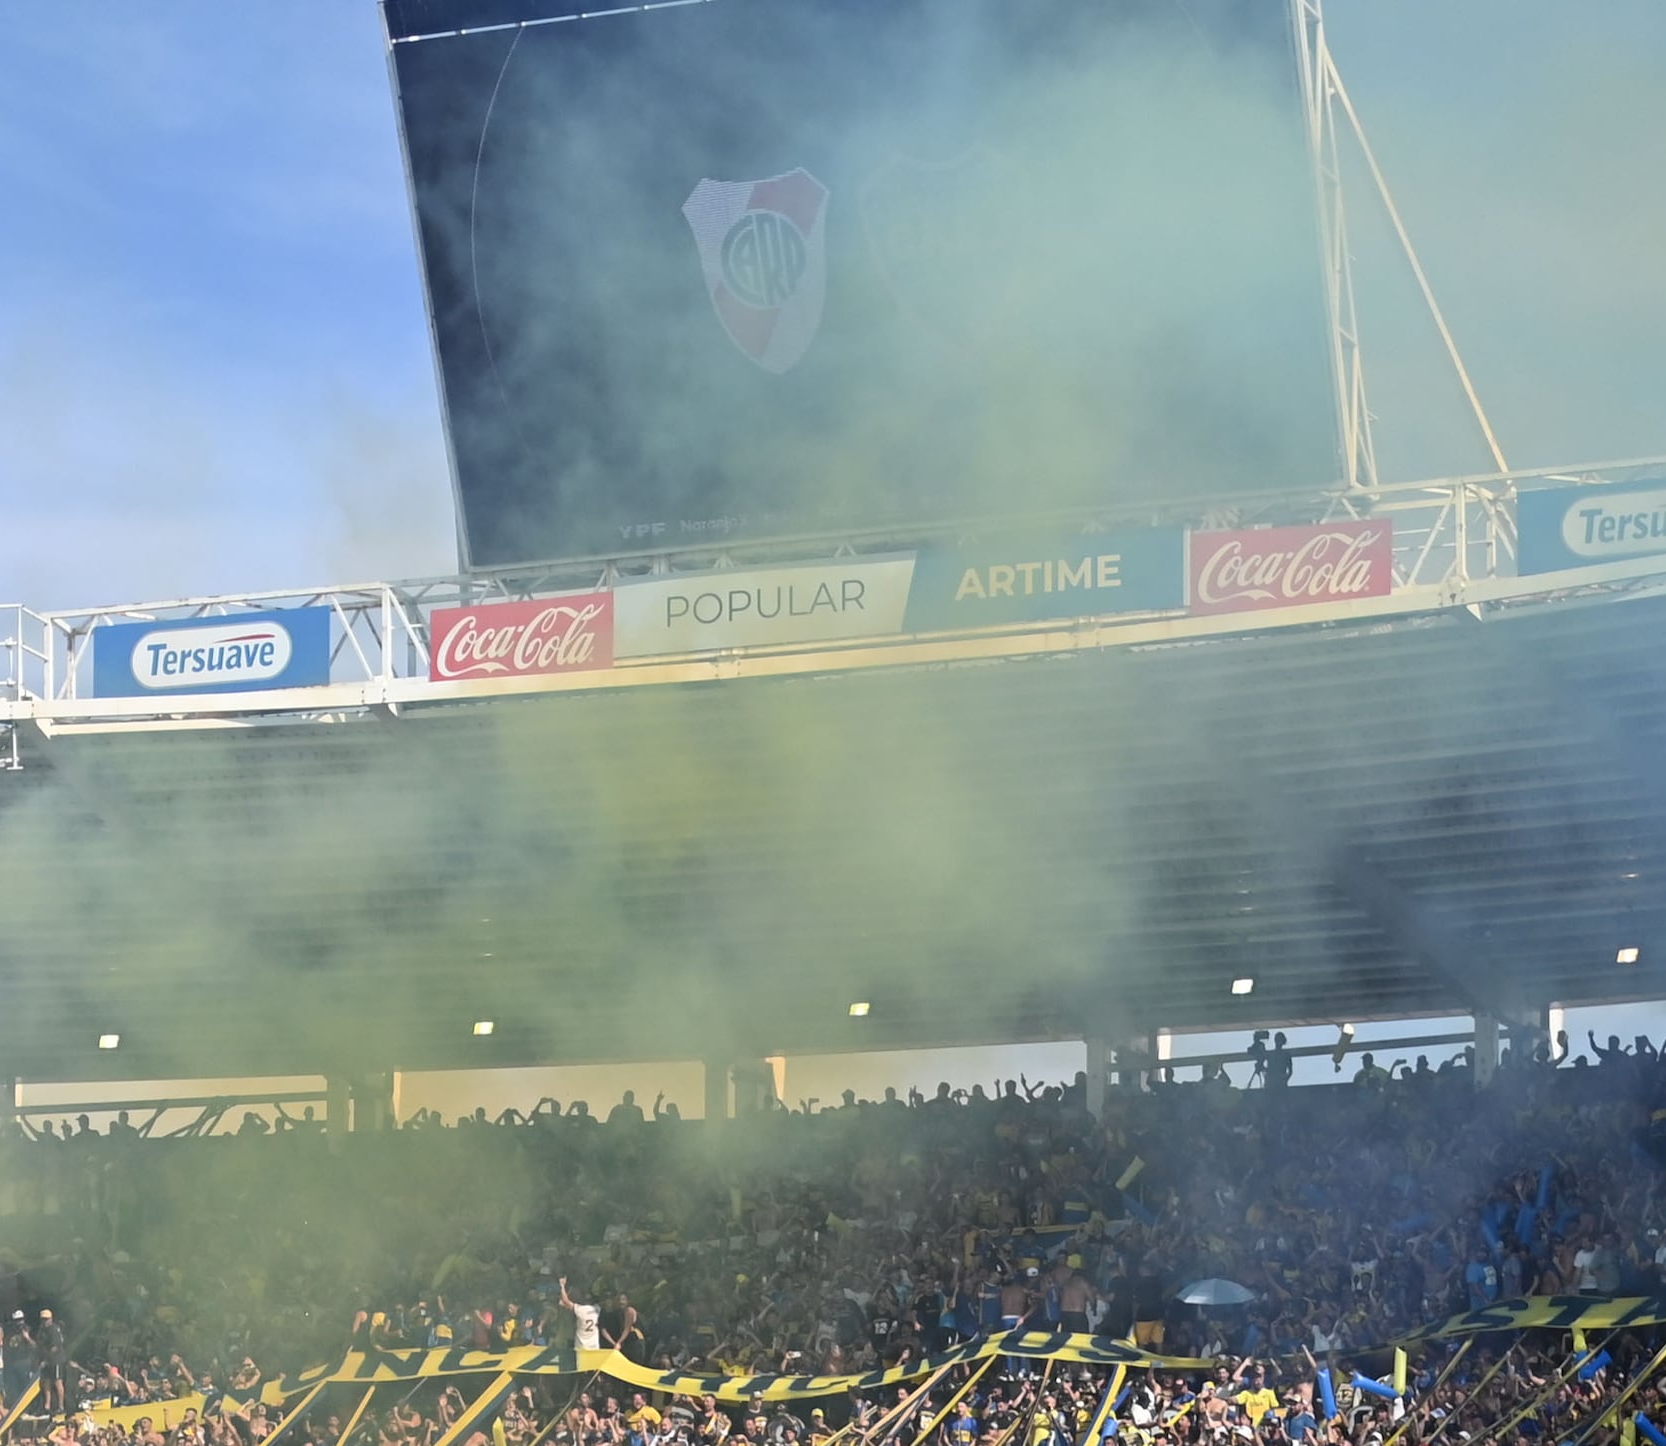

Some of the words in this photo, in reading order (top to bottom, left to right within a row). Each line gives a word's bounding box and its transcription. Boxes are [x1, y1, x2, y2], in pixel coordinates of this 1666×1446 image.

[957, 552, 1122, 602] ARTIME
[1200, 530, 1380, 605] Coca-Cola
[666, 578, 868, 630] POPULAR
[147, 636, 277, 677] Tersuave
[436, 603, 605, 681] Coca-Cola
